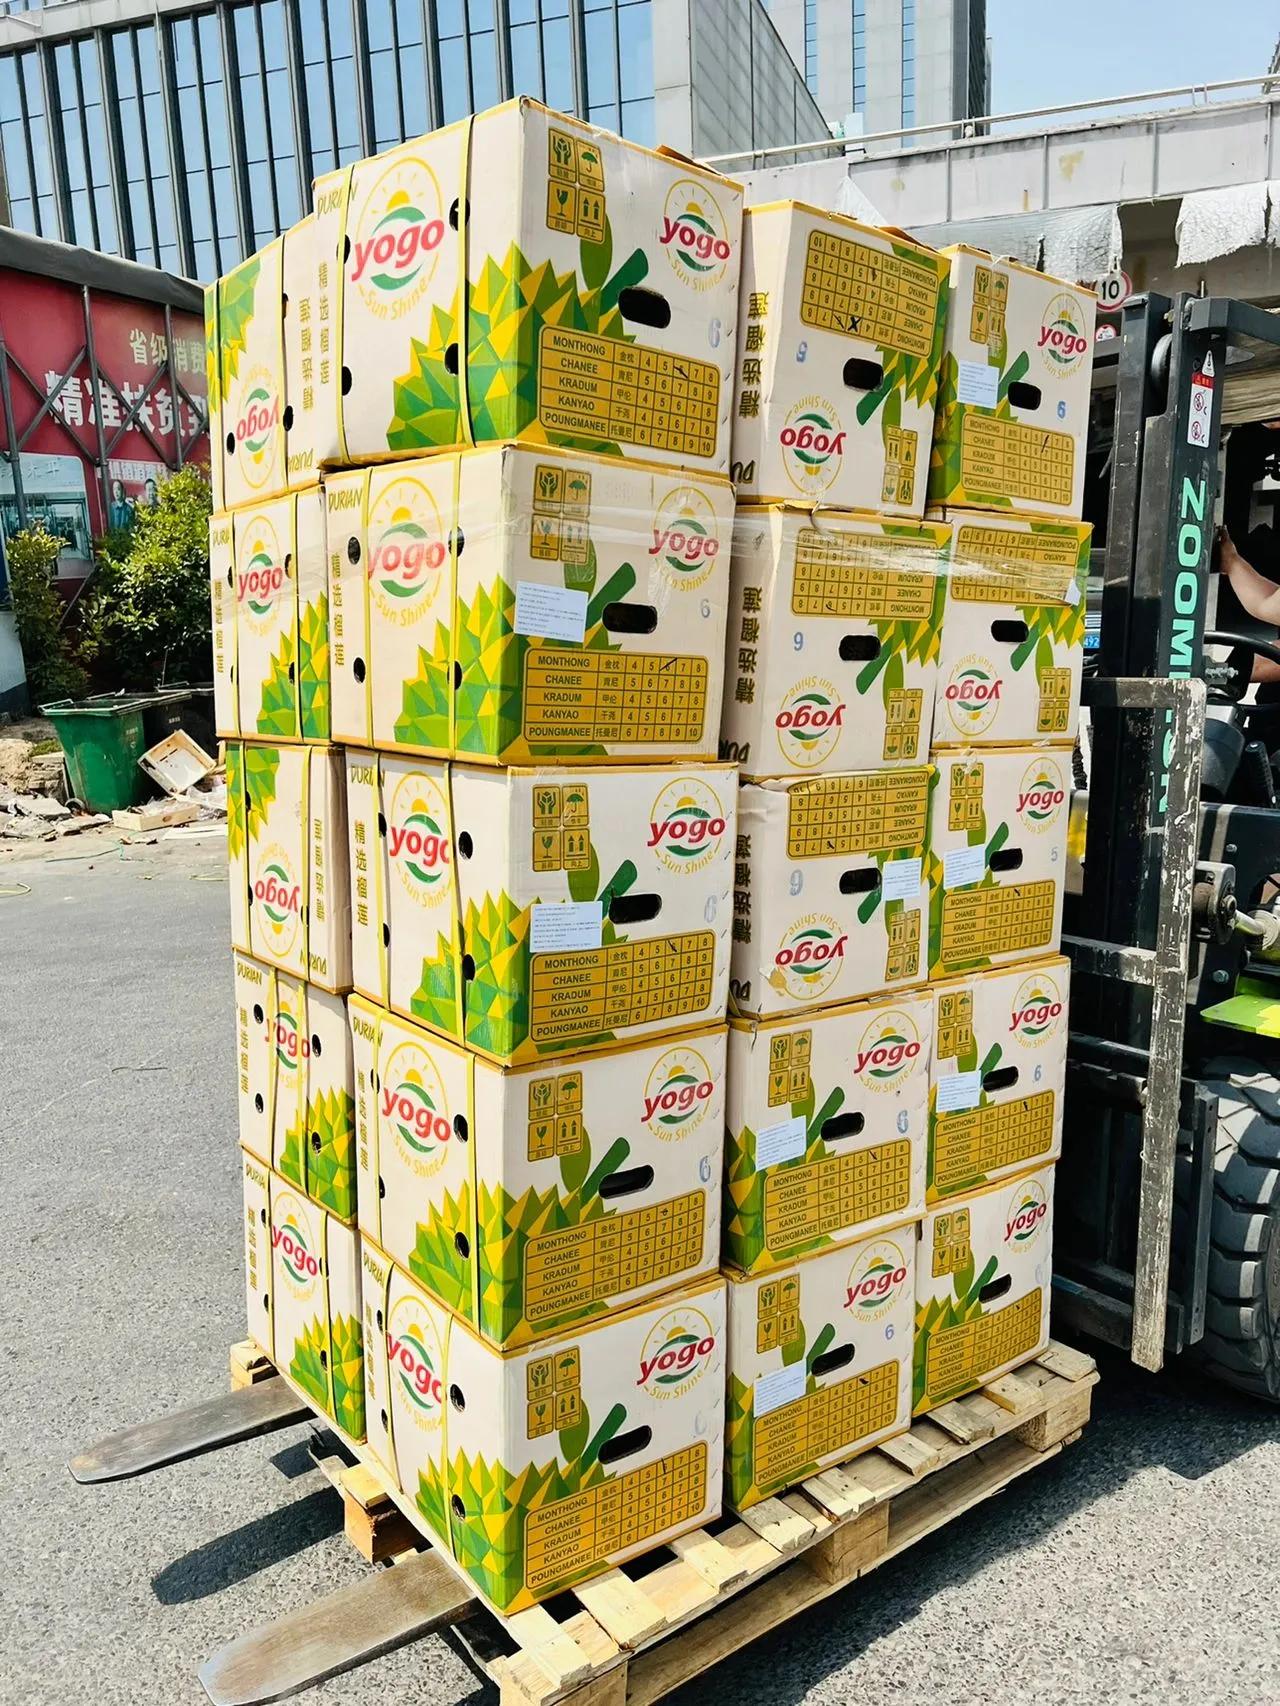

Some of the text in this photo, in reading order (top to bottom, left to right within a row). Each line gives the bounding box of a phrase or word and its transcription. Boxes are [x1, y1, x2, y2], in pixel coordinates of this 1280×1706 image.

[351, 219, 444, 282] yogo
[660, 217, 731, 261] yogo
[671, 260, 721, 292] Sun Shine
[365, 280, 427, 320] Sun Shine
[1102, 280, 1119, 300] 10
[903, 318, 923, 331] CHANEE
[553, 334, 605, 356] MONTHONG
[1038, 327, 1087, 354] yogo
[560, 356, 597, 374] CHANEE
[740, 291, 770, 419] 精选榴莲
[559, 376, 597, 393] KRADUM
[558, 394, 594, 410] KANYAO
[793, 395, 837, 421] Sun Shine
[1057, 400, 1066, 419] 6
[236, 396, 280, 441] yogo
[545, 412, 605, 432] POUNGMANEE
[780, 425, 847, 455] yogo
[329, 488, 362, 511] DURIAN
[648, 528, 719, 561] yogo
[368, 541, 446, 580] yogo
[238, 566, 283, 602] yogo
[896, 589, 920, 597] CHANEE
[376, 594, 433, 627] Sun Shine
[701, 599, 710, 619] 6
[890, 604, 923, 612] MONTHONG
[735, 587, 763, 704] 精选榴莲
[538, 656, 589, 667] MONTHONG
[604, 660, 619, 670] 金枕
[631, 660, 637, 669] 4
[649, 661, 654, 671] 5
[680, 663, 685, 672] 7
[696, 664, 701, 672] 8
[545, 674, 581, 684] CHANEE
[630, 678, 636, 686] 5
[647, 679, 653, 687] 6
[663, 680, 669, 688] 7
[679, 680, 685, 689] 8
[695, 680, 700, 689] 9
[789, 676, 836, 697] Sun Shine
[945, 680, 1002, 700] yogo
[544, 692, 581, 702] KRADUM
[628, 695, 634, 704] 4
[646, 696, 651, 704] 5
[662, 696, 667, 705] 6
[677, 696, 683, 705] 7
[693, 697, 698, 705] 8
[542, 709, 578, 719] KANYAO
[627, 711, 633, 720] 4
[644, 712, 650, 720] 5
[660, 712, 666, 721] 6
[676, 712, 681, 721] 7
[692, 712, 697, 721] 8
[775, 704, 845, 729] yogo
[529, 727, 590, 736] POUNGMANEE
[626, 728, 631, 737] 6
[643, 728, 648, 737] 7
[659, 728, 665, 737] 8
[675, 728, 680, 737] 9
[689, 728, 697, 736] 10
[1017, 789, 1064, 811] yogo
[647, 817, 726, 847] yogo
[893, 817, 915, 826] CHANEE
[661, 850, 713, 874] Sun Shine
[254, 877, 301, 912] yogo
[730, 834, 752, 945] 精选榴莲
[788, 913, 838, 936] Sun Shine
[544, 953, 598, 970] MONTHONG
[775, 935, 848, 967] yogo
[237, 961, 262, 985] DURIAN
[553, 971, 590, 986] CHANEE
[551, 987, 591, 1003] KRADUM
[550, 1003, 588, 1018] KANYAO
[1010, 1002, 1062, 1031] yogo
[537, 1017, 600, 1038] POUNGMANEE
[854, 1041, 921, 1074] yogo
[863, 1071, 908, 1093] Sun Shine
[1034, 1064, 1042, 1082] 6
[641, 1081, 714, 1122] yogo
[382, 1088, 452, 1142] yogo
[897, 1109, 908, 1134] 6
[653, 1114, 704, 1141] Sun Shine
[700, 1155, 711, 1183] 6
[773, 1169, 811, 1187] MONTHONG
[779, 1185, 806, 1199] CHANEE
[779, 1213, 806, 1228] KANYAO
[1004, 1201, 1046, 1241] yogo
[537, 1229, 586, 1252] MONTHONG
[770, 1224, 816, 1245] POUNGMANEE
[272, 1225, 318, 1277] yogo
[544, 1247, 579, 1265] CHANEE
[543, 1263, 579, 1282] KRADUM
[543, 1278, 577, 1296] KANYAO
[844, 1266, 907, 1308] yogo
[530, 1289, 590, 1316] POUNGMANEE
[885, 1324, 894, 1341] 6
[637, 1336, 715, 1386] yogo
[649, 1371, 704, 1400] Sun Shine
[537, 1495, 587, 1523] MONTHONG
[545, 1513, 580, 1535] CHANEE
[544, 1527, 581, 1550] KRADUM
[544, 1542, 578, 1564] KANYAO
[531, 1551, 590, 1583] POUNGMANEE
